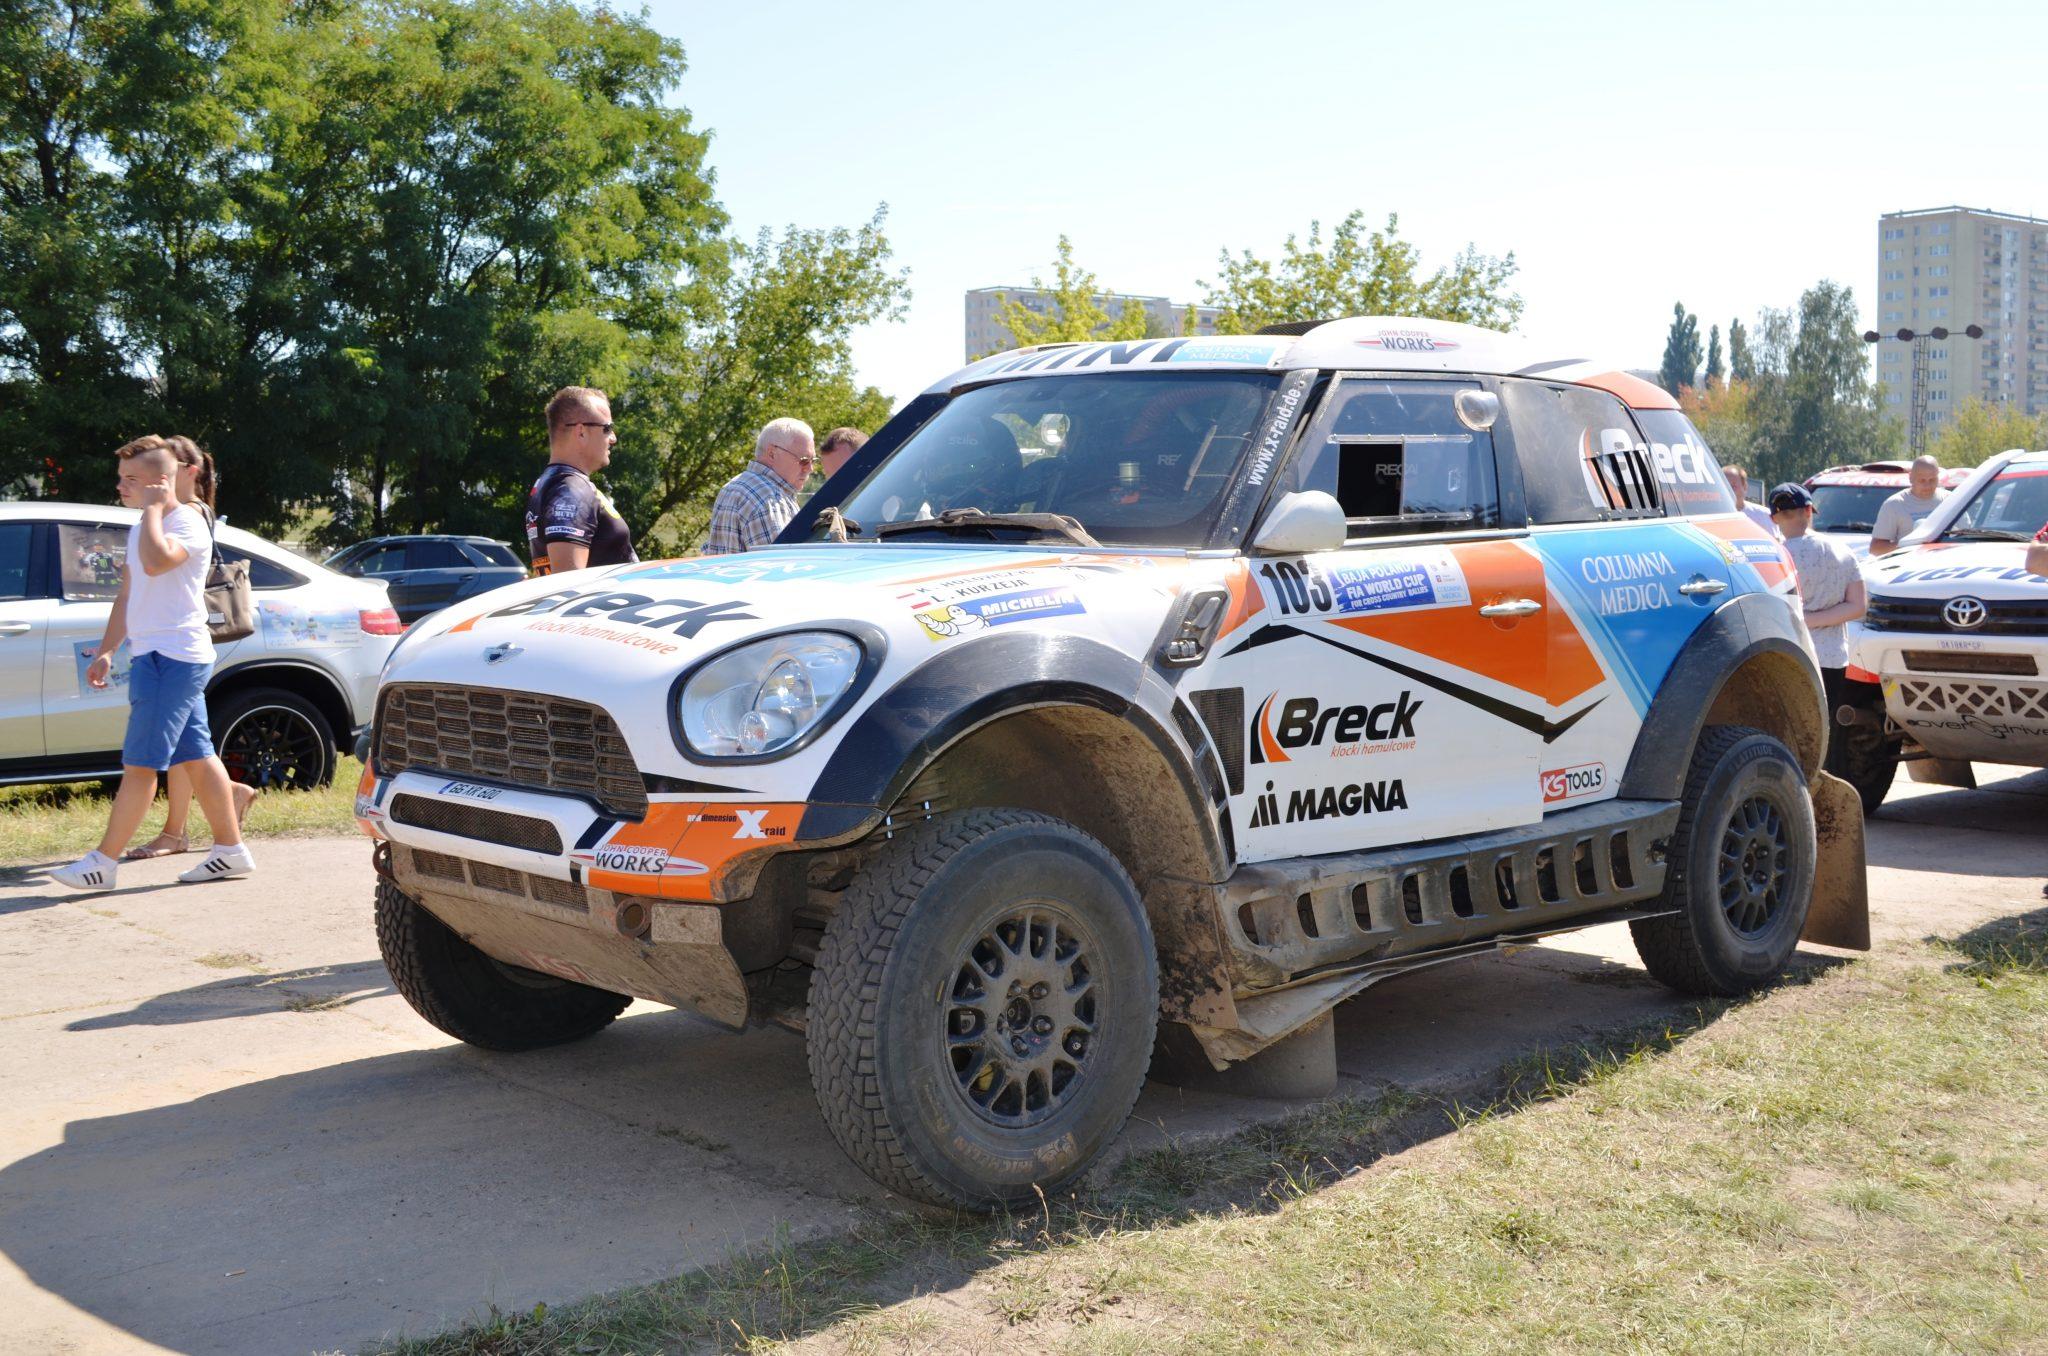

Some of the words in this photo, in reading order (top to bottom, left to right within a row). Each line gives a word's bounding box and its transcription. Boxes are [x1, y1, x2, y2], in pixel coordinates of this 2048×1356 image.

[1380, 337, 1435, 351] WORKS
[988, 339, 1190, 375] MINI
[1247, 388, 1302, 486] www.x-raid.de
[1581, 551, 1677, 584] COLUMNA
[955, 578, 1029, 599] KURZEJA
[1346, 586, 1365, 600] FIA
[1365, 578, 1403, 595] WORLD
[1403, 573, 1426, 588] CUP
[1600, 582, 1673, 616] MEDICA
[1351, 599, 1363, 609] FOR
[1363, 596, 1382, 606] CROSS
[1276, 690, 1424, 749] Breck
[1330, 745, 1362, 758] klocki
[1361, 740, 1417, 755] hamulcowe
[1565, 768, 1602, 791] TOOLS
[1286, 779, 1409, 824] MAGNA
[595, 851, 666, 873] WORKS
[600, 843, 625, 853] JOHN
[626, 844, 668, 857] COOPER
